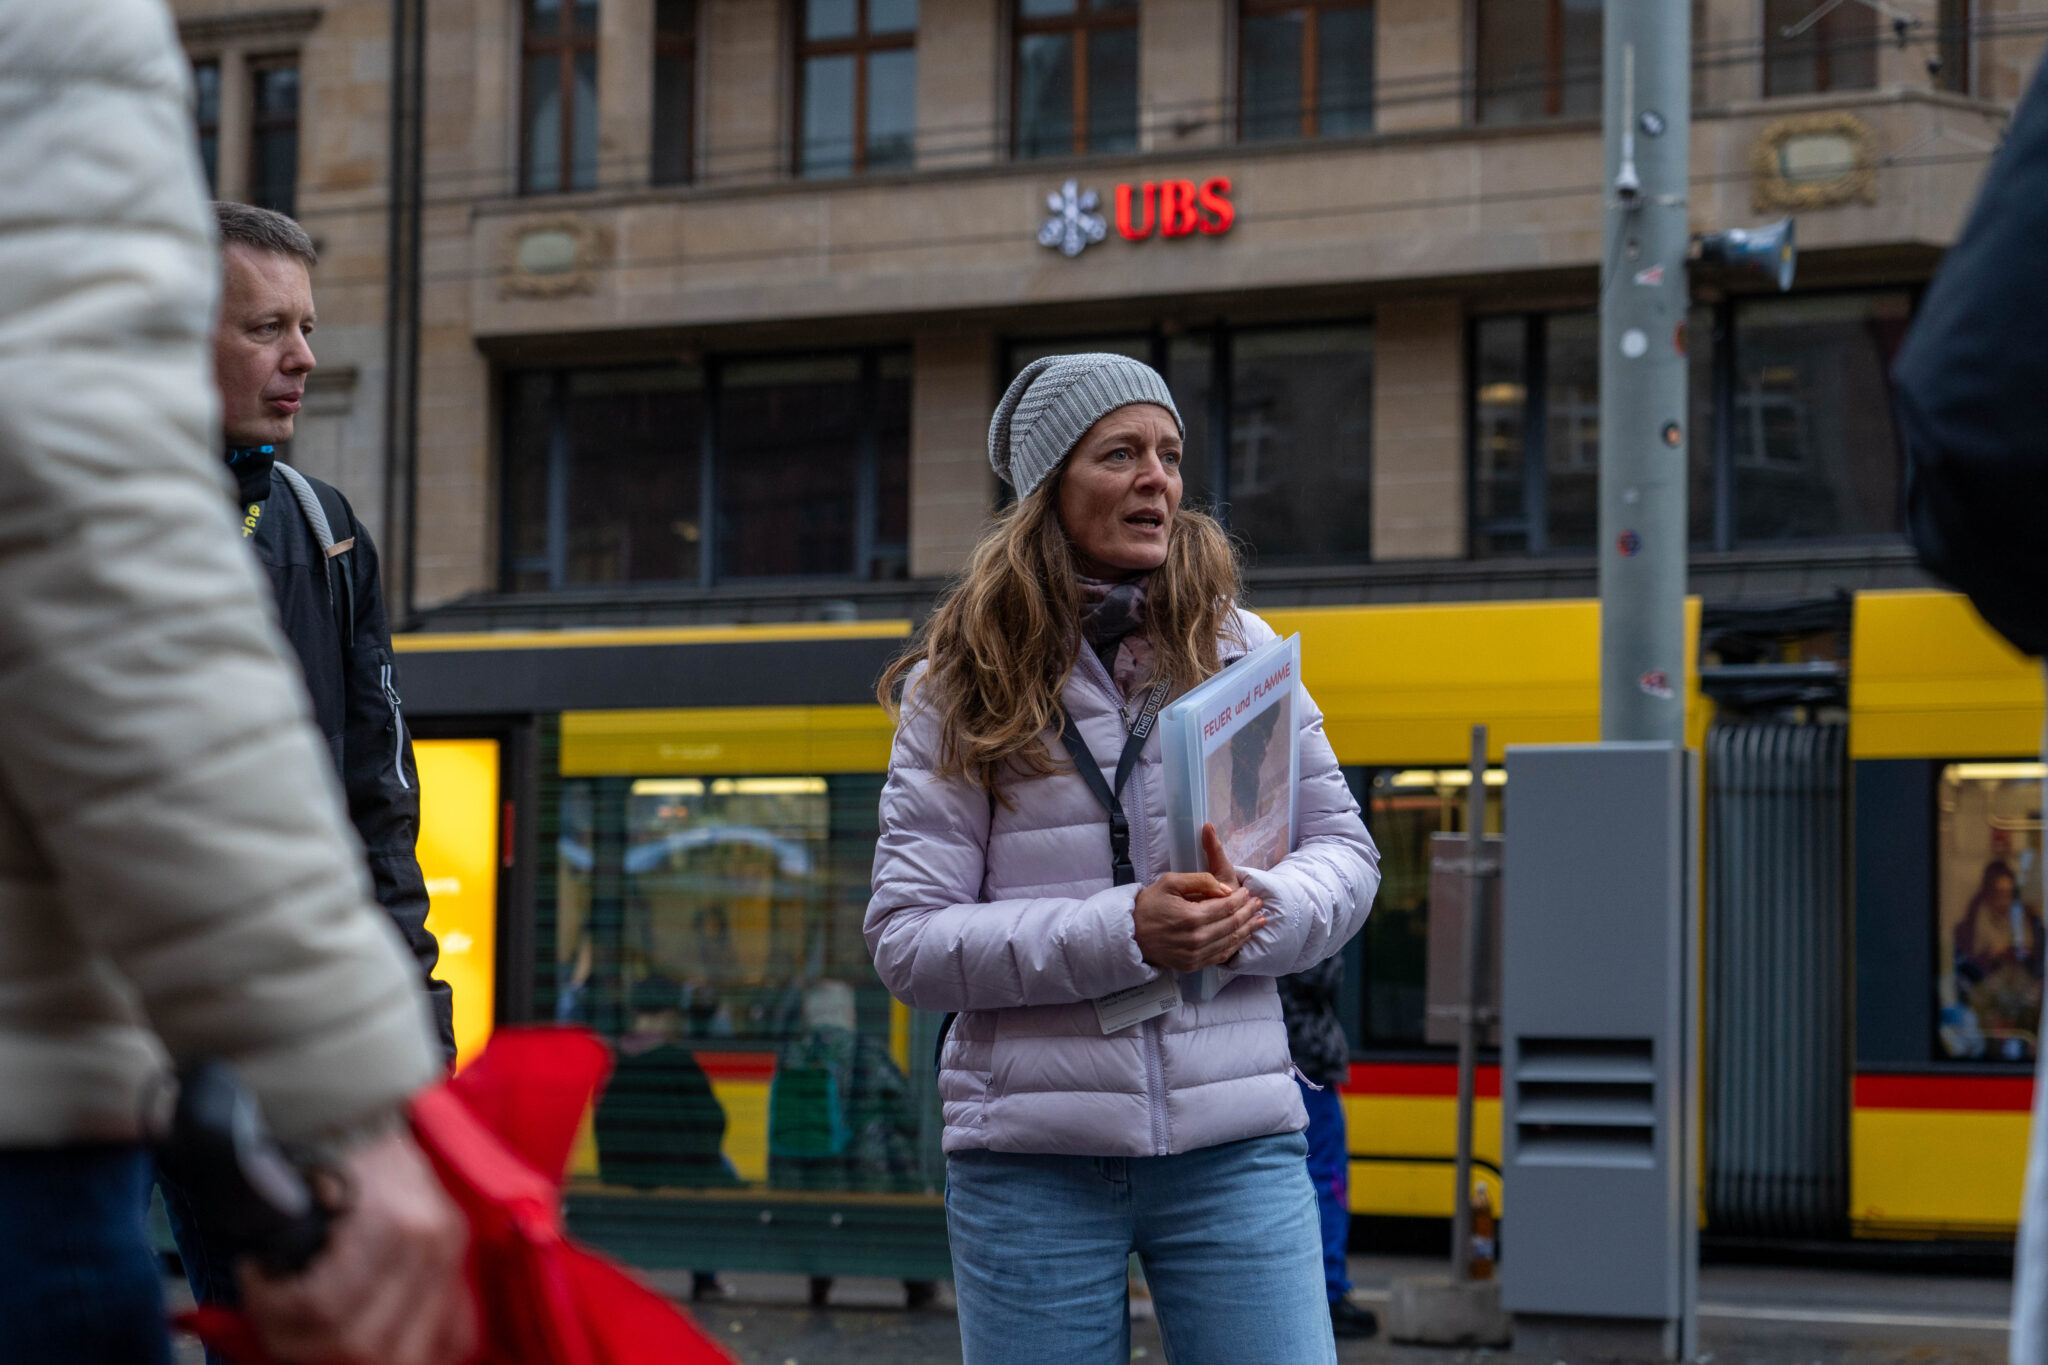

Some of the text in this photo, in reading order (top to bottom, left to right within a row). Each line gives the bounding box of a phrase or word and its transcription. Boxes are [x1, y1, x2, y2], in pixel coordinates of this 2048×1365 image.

[1115, 175, 1235, 240] UBS
[1136, 715, 1151, 734] THIS
[1148, 704, 1156, 714] IS
[1203, 662, 1290, 741] FEUER und FLAMME
